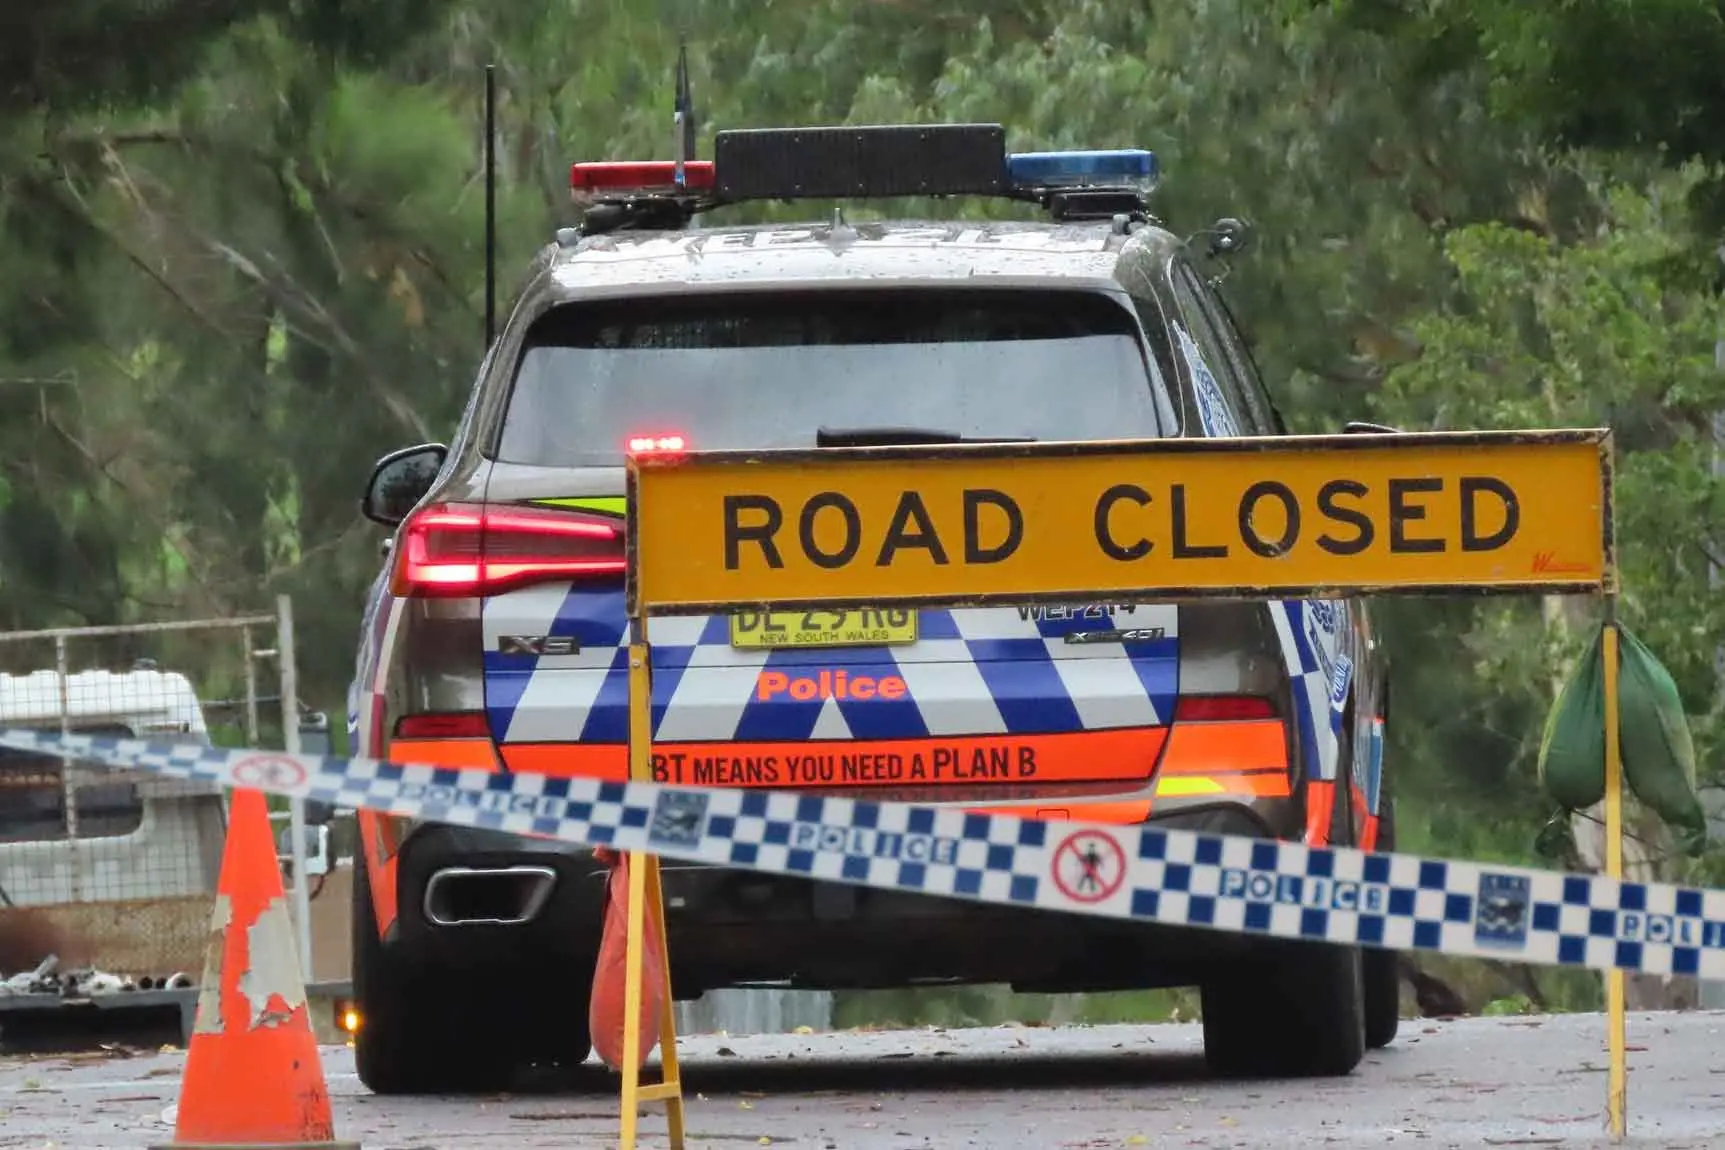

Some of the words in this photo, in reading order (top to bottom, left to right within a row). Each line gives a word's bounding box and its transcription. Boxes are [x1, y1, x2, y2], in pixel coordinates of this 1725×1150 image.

[724, 489, 1023, 570] ROAD
[1094, 477, 1520, 561] CLOSED
[760, 632, 788, 644] NEW
[794, 631, 839, 643] SOUTH
[846, 629, 889, 641] WALES
[757, 669, 907, 701] Police
[693, 755, 779, 784] MEANS
[785, 754, 834, 782] YOU
[841, 752, 903, 781] NEED
[910, 753, 926, 779] A
[932, 746, 1009, 778] PLAN
[1018, 745, 1037, 777] B
[796, 824, 958, 863] POLICE
[1223, 869, 1383, 911] POLICE
